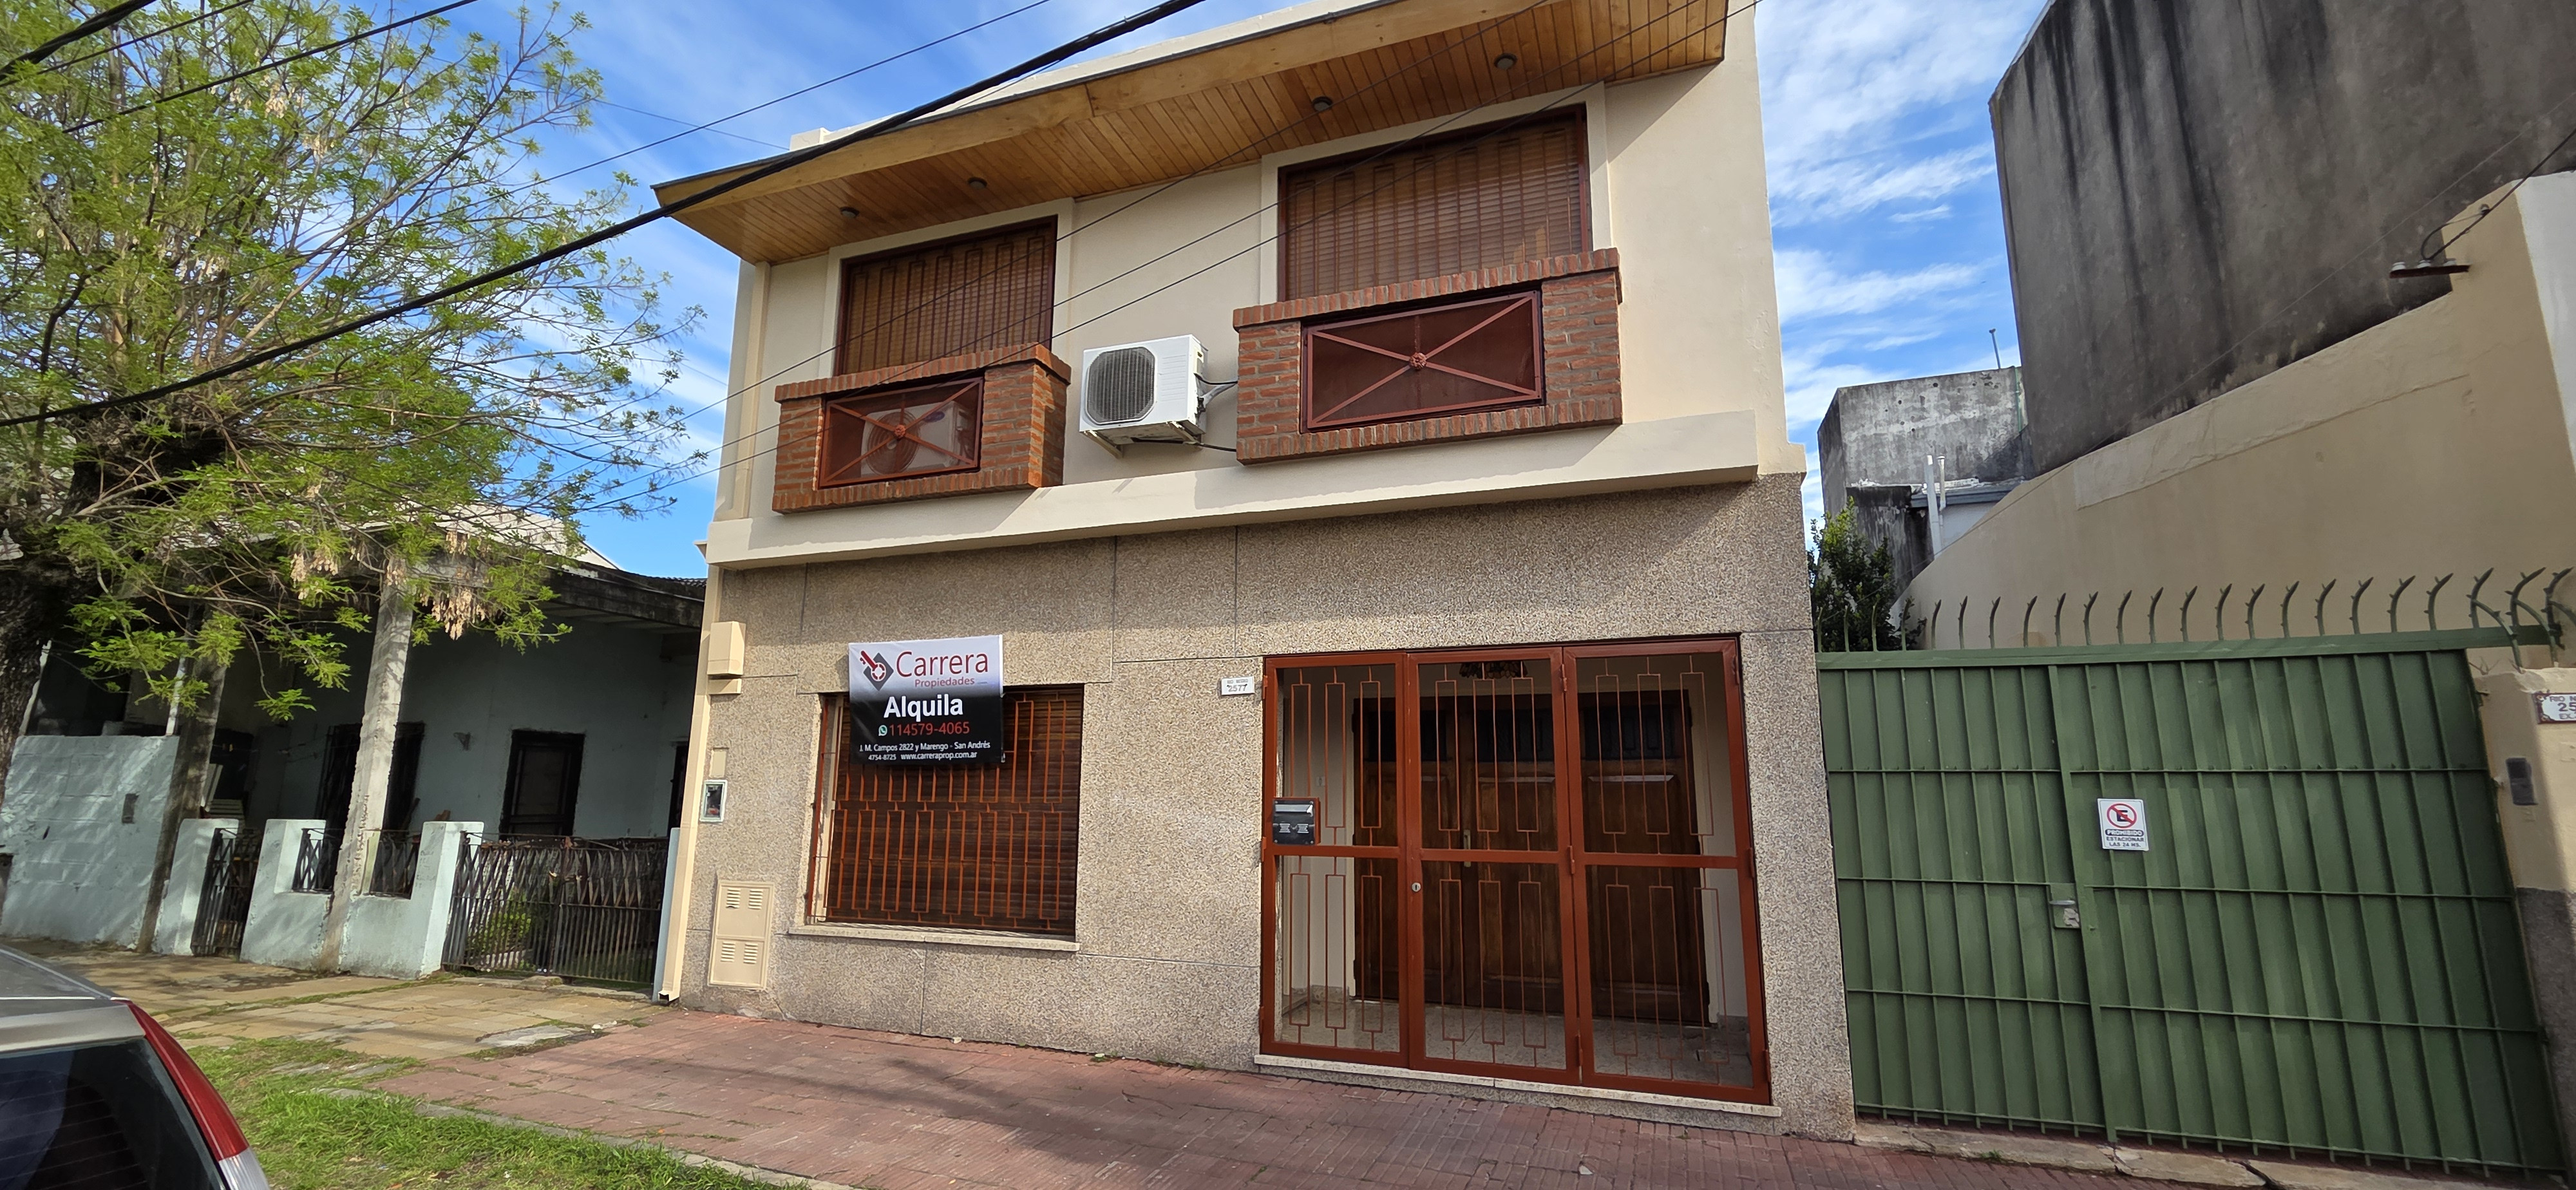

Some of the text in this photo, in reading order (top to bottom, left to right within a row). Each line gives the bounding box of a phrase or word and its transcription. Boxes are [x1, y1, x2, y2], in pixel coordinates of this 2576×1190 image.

[896, 651, 989, 677] Carrera
[914, 677, 975, 689] Propiedades
[1228, 684, 1247, 692] 2577
[884, 694, 963, 722] Alquila
[889, 721, 971, 737] 114579-4065
[873, 744, 898, 753] Campos
[920, 742, 949, 751] Marengo
[900, 752, 978, 760] www.carreraprop.com.ar
